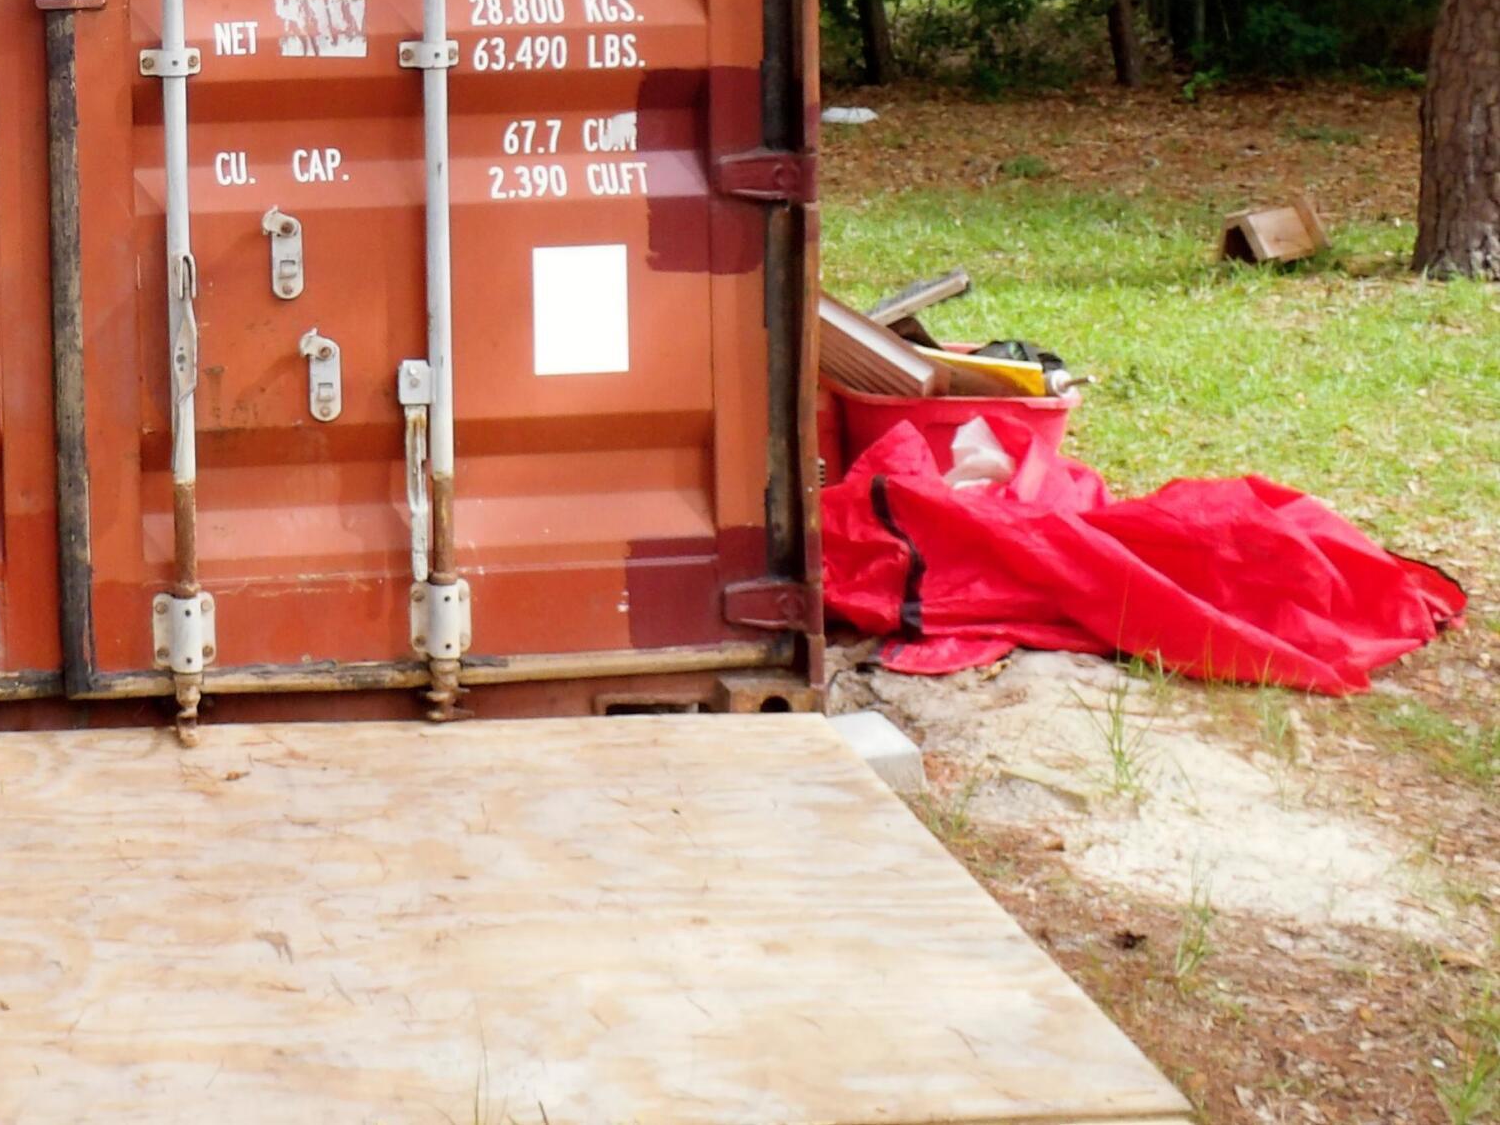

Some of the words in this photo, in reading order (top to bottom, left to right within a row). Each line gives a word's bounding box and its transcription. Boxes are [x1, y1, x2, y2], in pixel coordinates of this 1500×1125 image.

[214, 21, 259, 56] NET
[587, 33, 646, 69] LBS.
[503, 119, 562, 155] 67.7
[215, 151, 257, 186] CU.
[292, 147, 350, 183] CAP.
